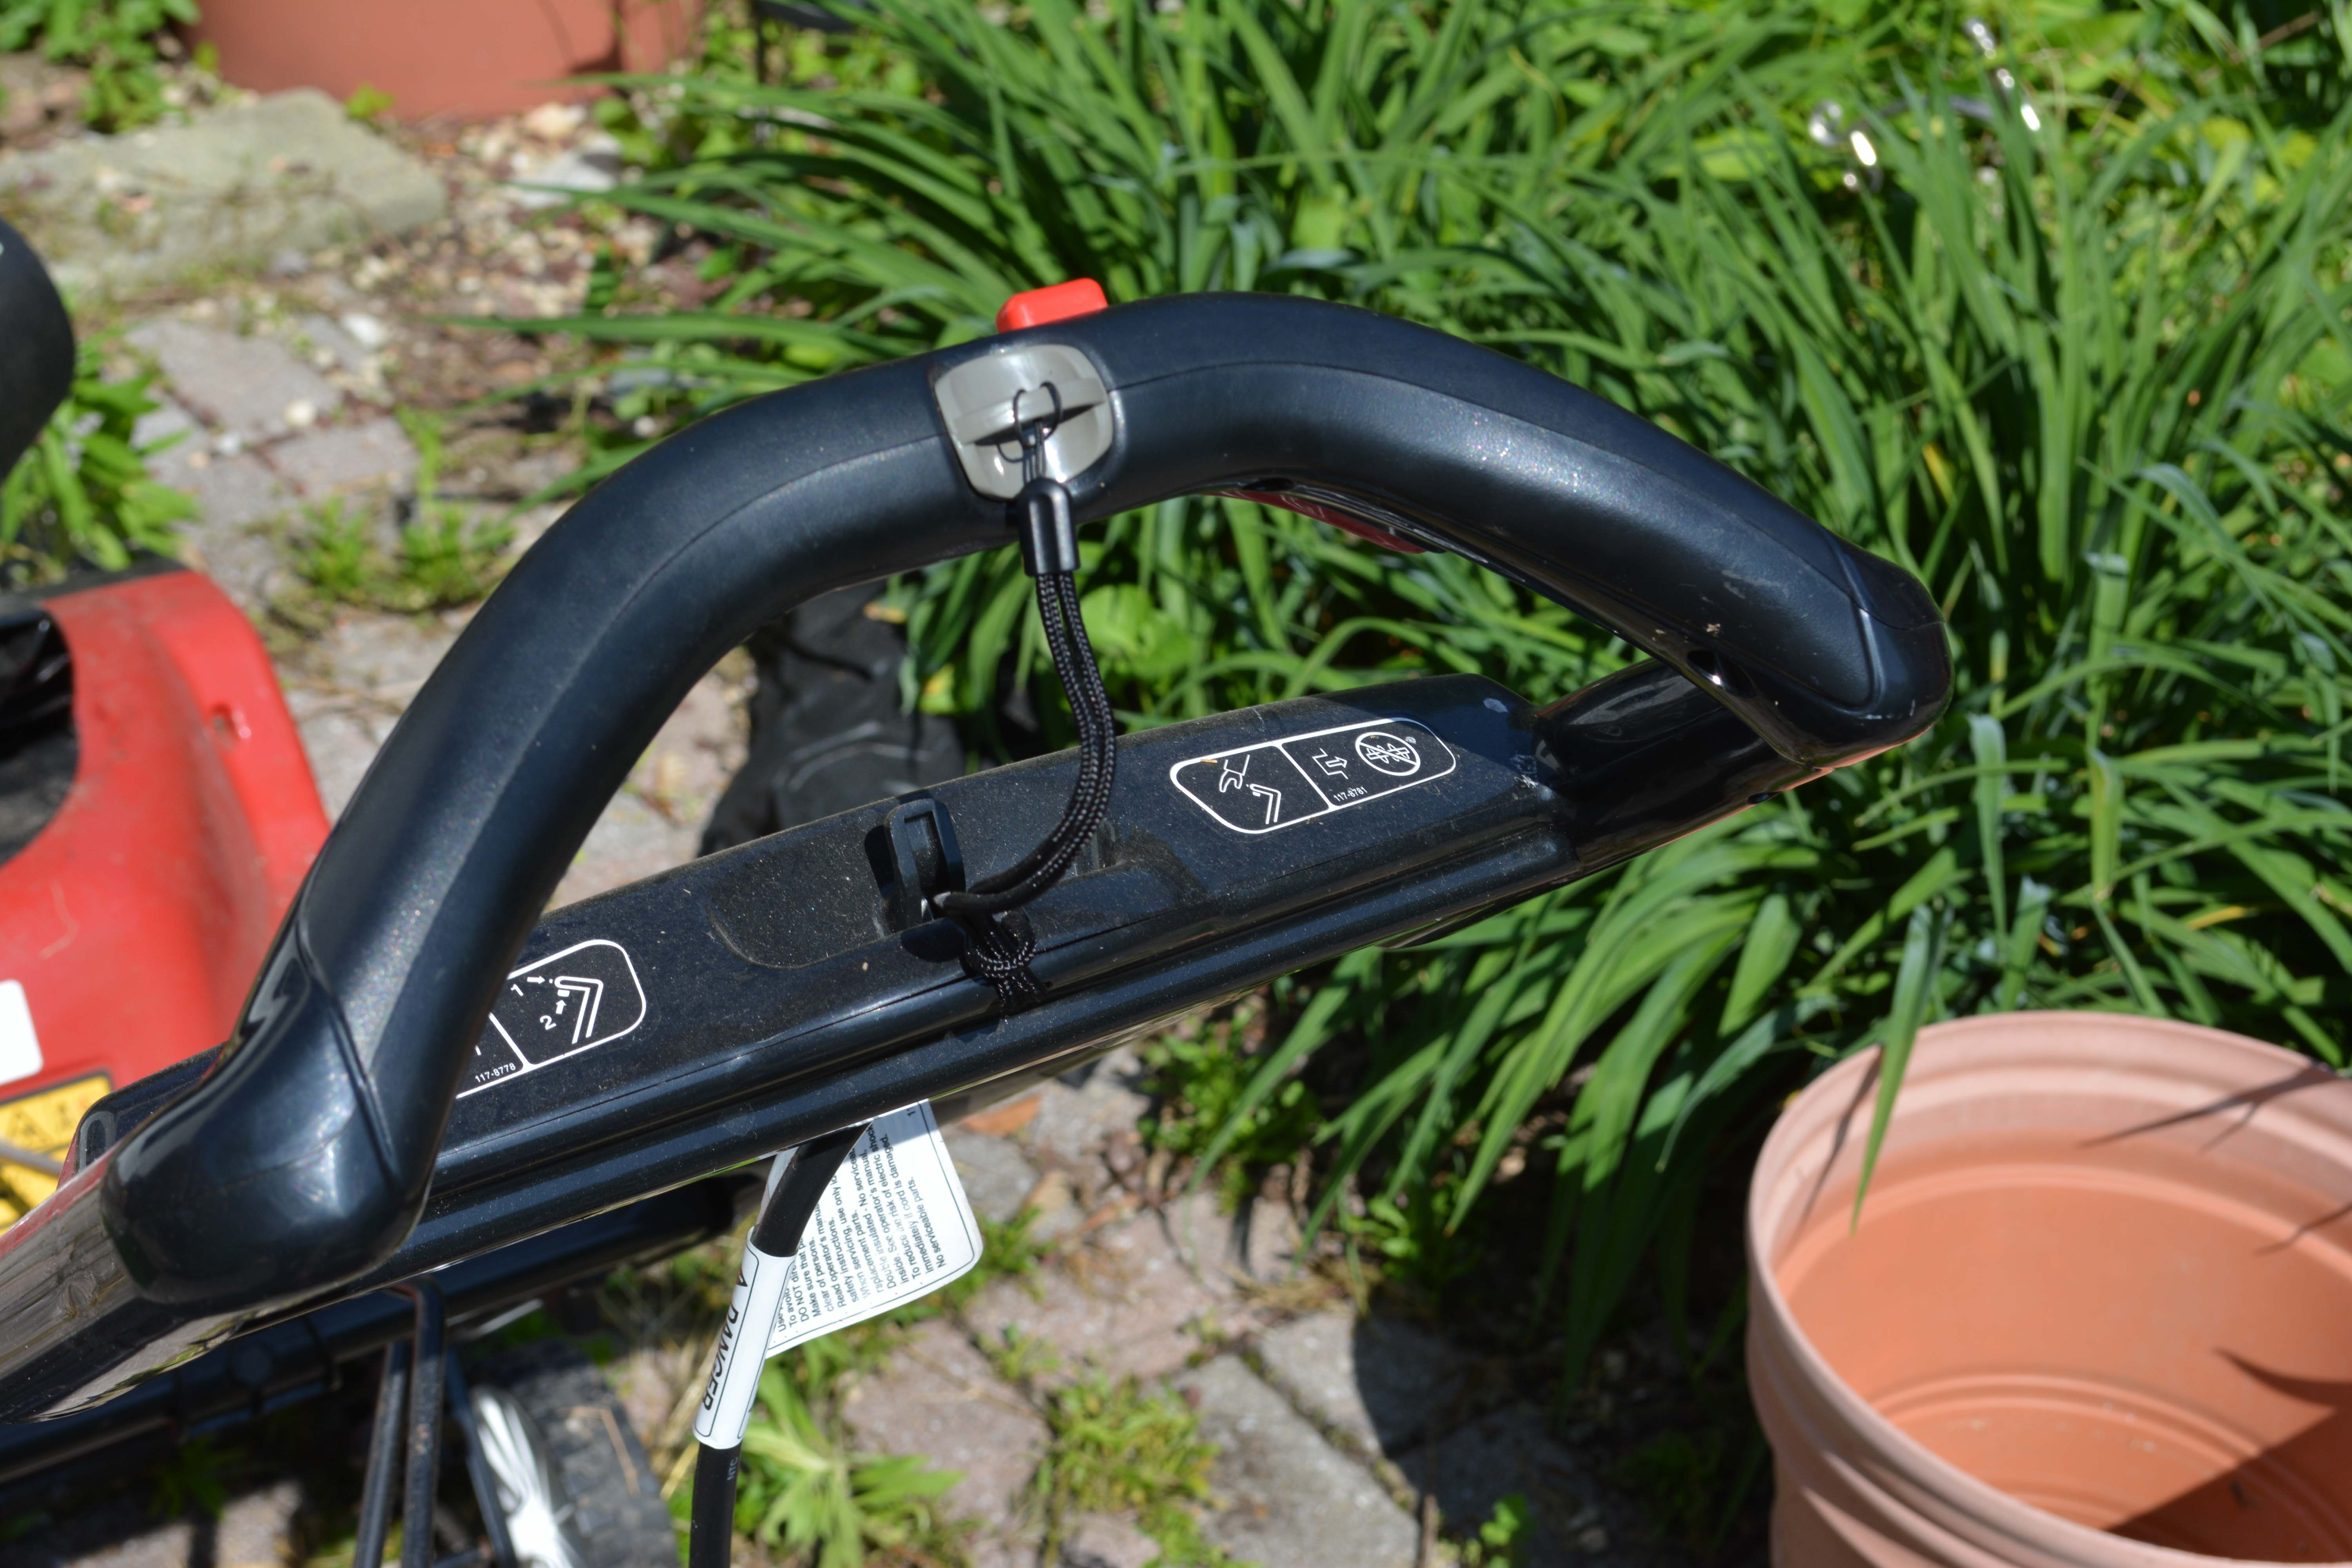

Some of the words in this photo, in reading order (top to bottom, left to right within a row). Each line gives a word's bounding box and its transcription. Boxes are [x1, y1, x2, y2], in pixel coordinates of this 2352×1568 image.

[1333, 786, 1368, 802] 117-8781
[510, 984, 524, 996] 1
[539, 1015, 557, 1030] 2
[475, 1063, 516, 1083] 117-8778
[880, 1134, 898, 1178] damaged.
[859, 1150, 875, 1185] manual.
[873, 1154, 888, 1187] electric
[881, 1189, 892, 1198] of
[894, 1180, 902, 1189] is
[908, 1177, 924, 1202] parts.
[832, 1187, 842, 1205] only
[858, 1193, 868, 1207] No
[896, 1190, 910, 1210] cord
[838, 1207, 847, 1224] use
[869, 1187, 890, 1233] operator's
[886, 1200, 898, 1217] risk
[851, 1210, 866, 1236] parts.
[862, 1213, 884, 1255] insulated
[917, 1204, 941, 1253] serviceable
[828, 1217, 848, 1274] instructions.
[843, 1225, 861, 1270] servicing,
[886, 1236, 897, 1252] See
[900, 1235, 917, 1265] reduce
[909, 1221, 934, 1274] immediately
[798, 1250, 808, 1269] that
[809, 1237, 825, 1276] persons.
[819, 1236, 838, 1282] operator's
[936, 1254, 946, 1268] No
[804, 1270, 814, 1290] sure
[880, 1257, 897, 1289] Double
[894, 1254, 909, 1284] inside.
[912, 1267, 921, 1279] To
[816, 1279, 826, 1288] of
[844, 1276, 858, 1302] safety
[857, 1272, 870, 1298] When
[792, 1286, 805, 1305] NOT
[809, 1292, 822, 1317] Make
[821, 1290, 834, 1312] clear
[831, 1283, 847, 1308] Read
[789, 1315, 797, 1327] To
[798, 1307, 809, 1322] DO
